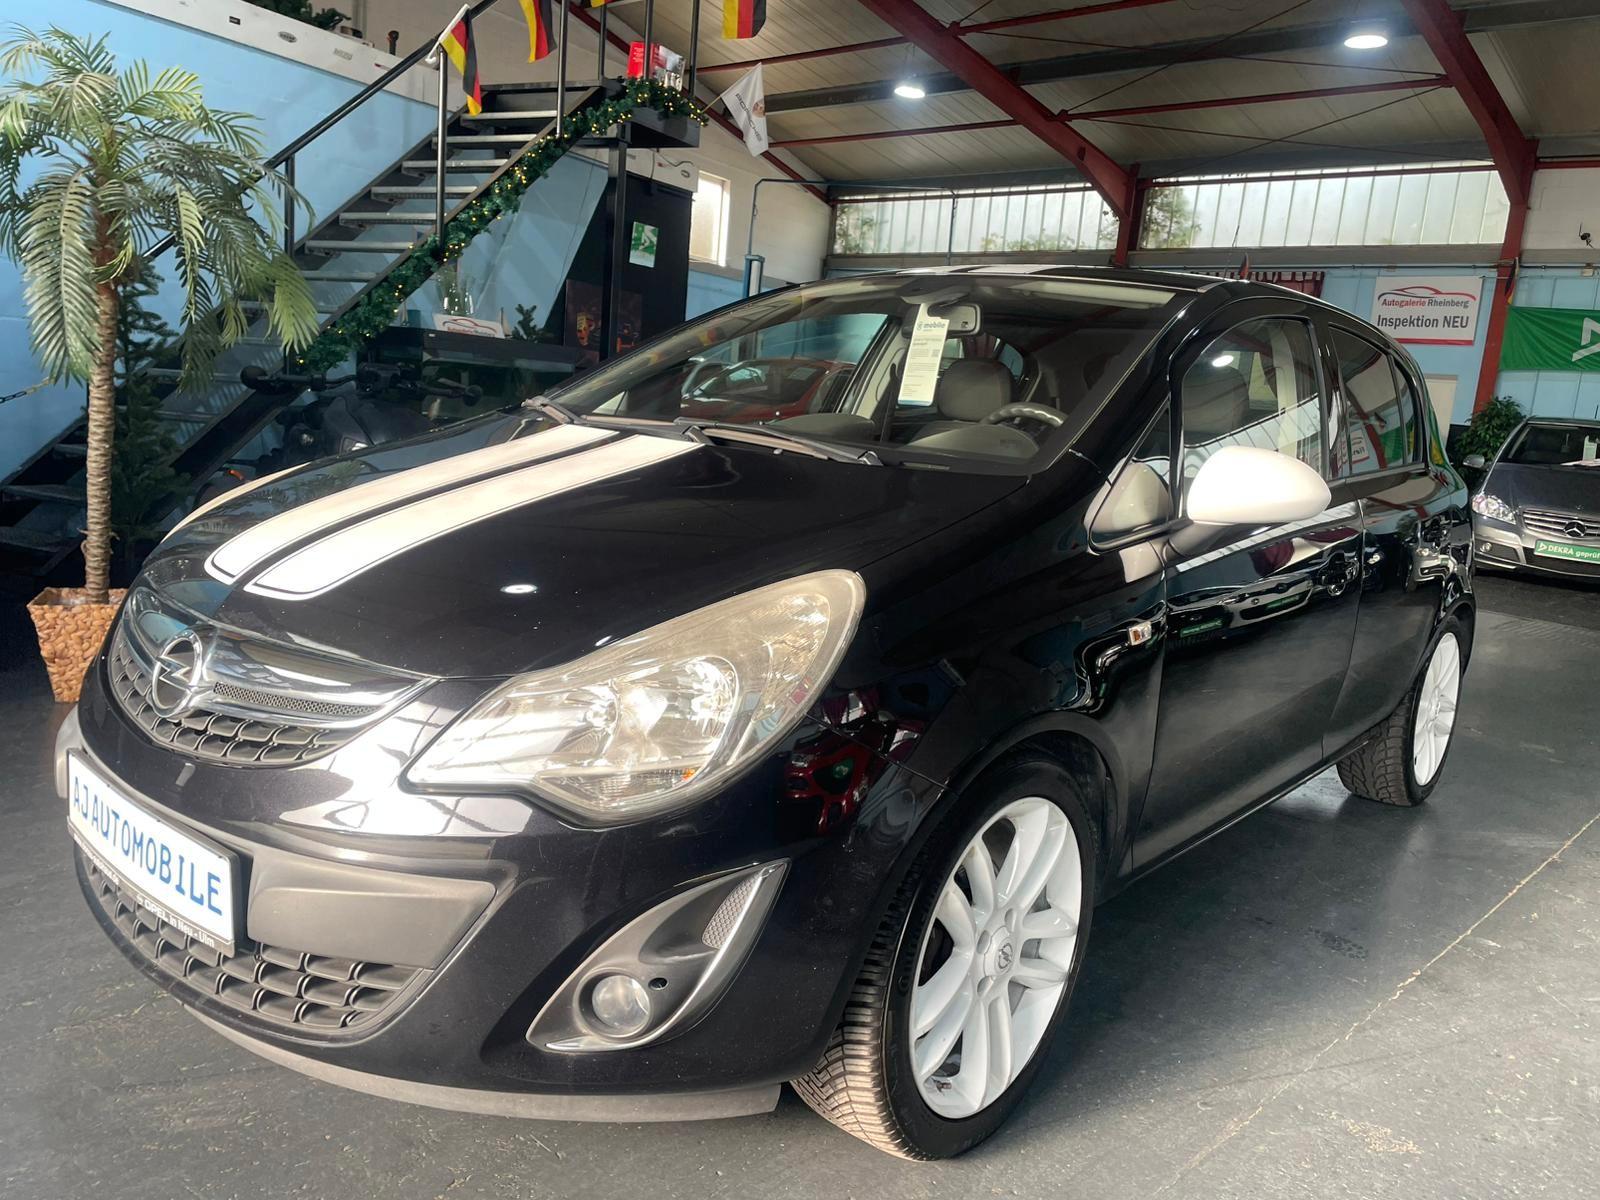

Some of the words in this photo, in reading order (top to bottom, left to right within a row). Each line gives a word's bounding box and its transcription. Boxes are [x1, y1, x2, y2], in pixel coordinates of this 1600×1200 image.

[1381, 299, 1426, 308] Autogalerie
[1427, 299, 1469, 309] Rheinberg
[1377, 314, 1439, 330] Inspektion
[1442, 315, 1470, 329] NEU
[1547, 545, 1574, 555] DEKRA
[144, 899, 168, 920] OPEL
[198, 930, 215, 949] Ulm
